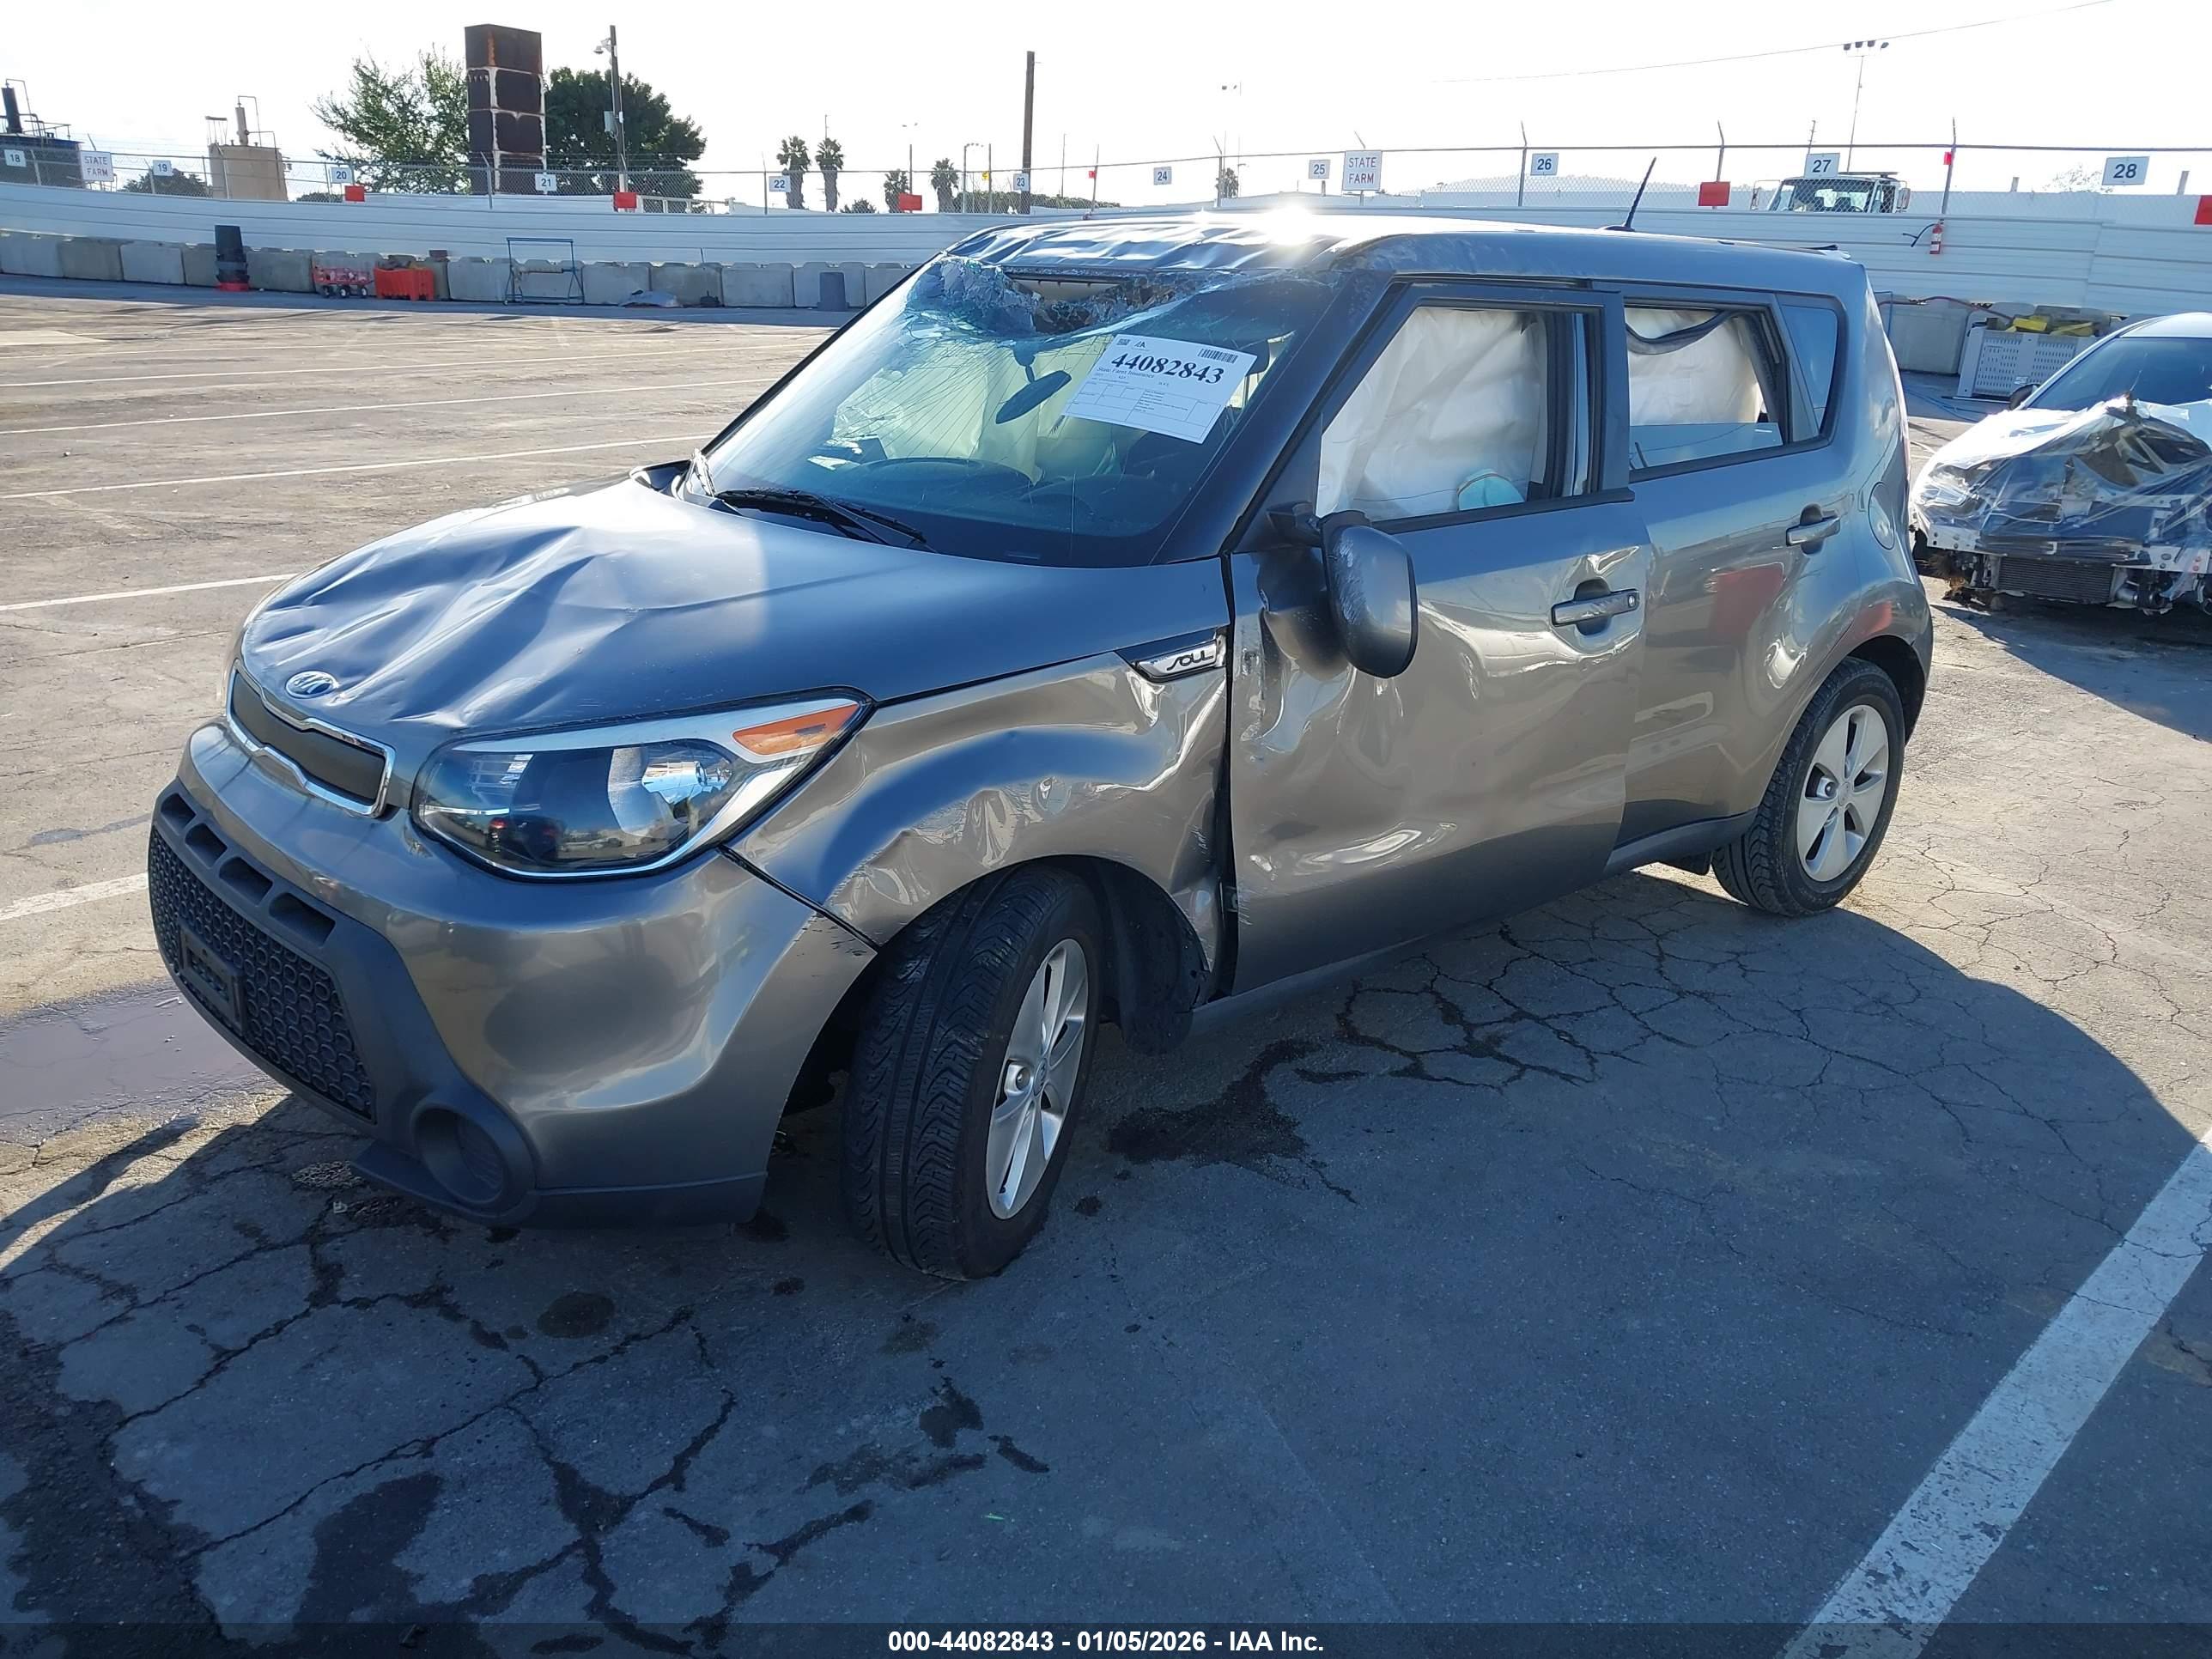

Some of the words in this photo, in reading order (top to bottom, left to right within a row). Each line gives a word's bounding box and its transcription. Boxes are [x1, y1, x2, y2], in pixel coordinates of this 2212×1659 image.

[9, 154, 21, 164] 18
[83, 156, 108, 167] STATE
[1348, 157, 1377, 169] STATE
[1536, 158, 1553, 171] 26
[157, 162, 168, 173] 19
[1313, 163, 1326, 174] 25
[1813, 159, 1832, 173] 27
[2113, 163, 2137, 179] 28
[86, 167, 109, 177] FARM
[336, 170, 347, 179] 20
[1157, 171, 1168, 182] 24
[541, 177, 553, 187] 21
[775, 179, 786, 188] 22
[1016, 177, 1026, 187] 23
[1349, 173, 1375, 185] FARM
[1111, 353, 1224, 384] 44082843
[1166, 650, 1214, 671] SOUL
